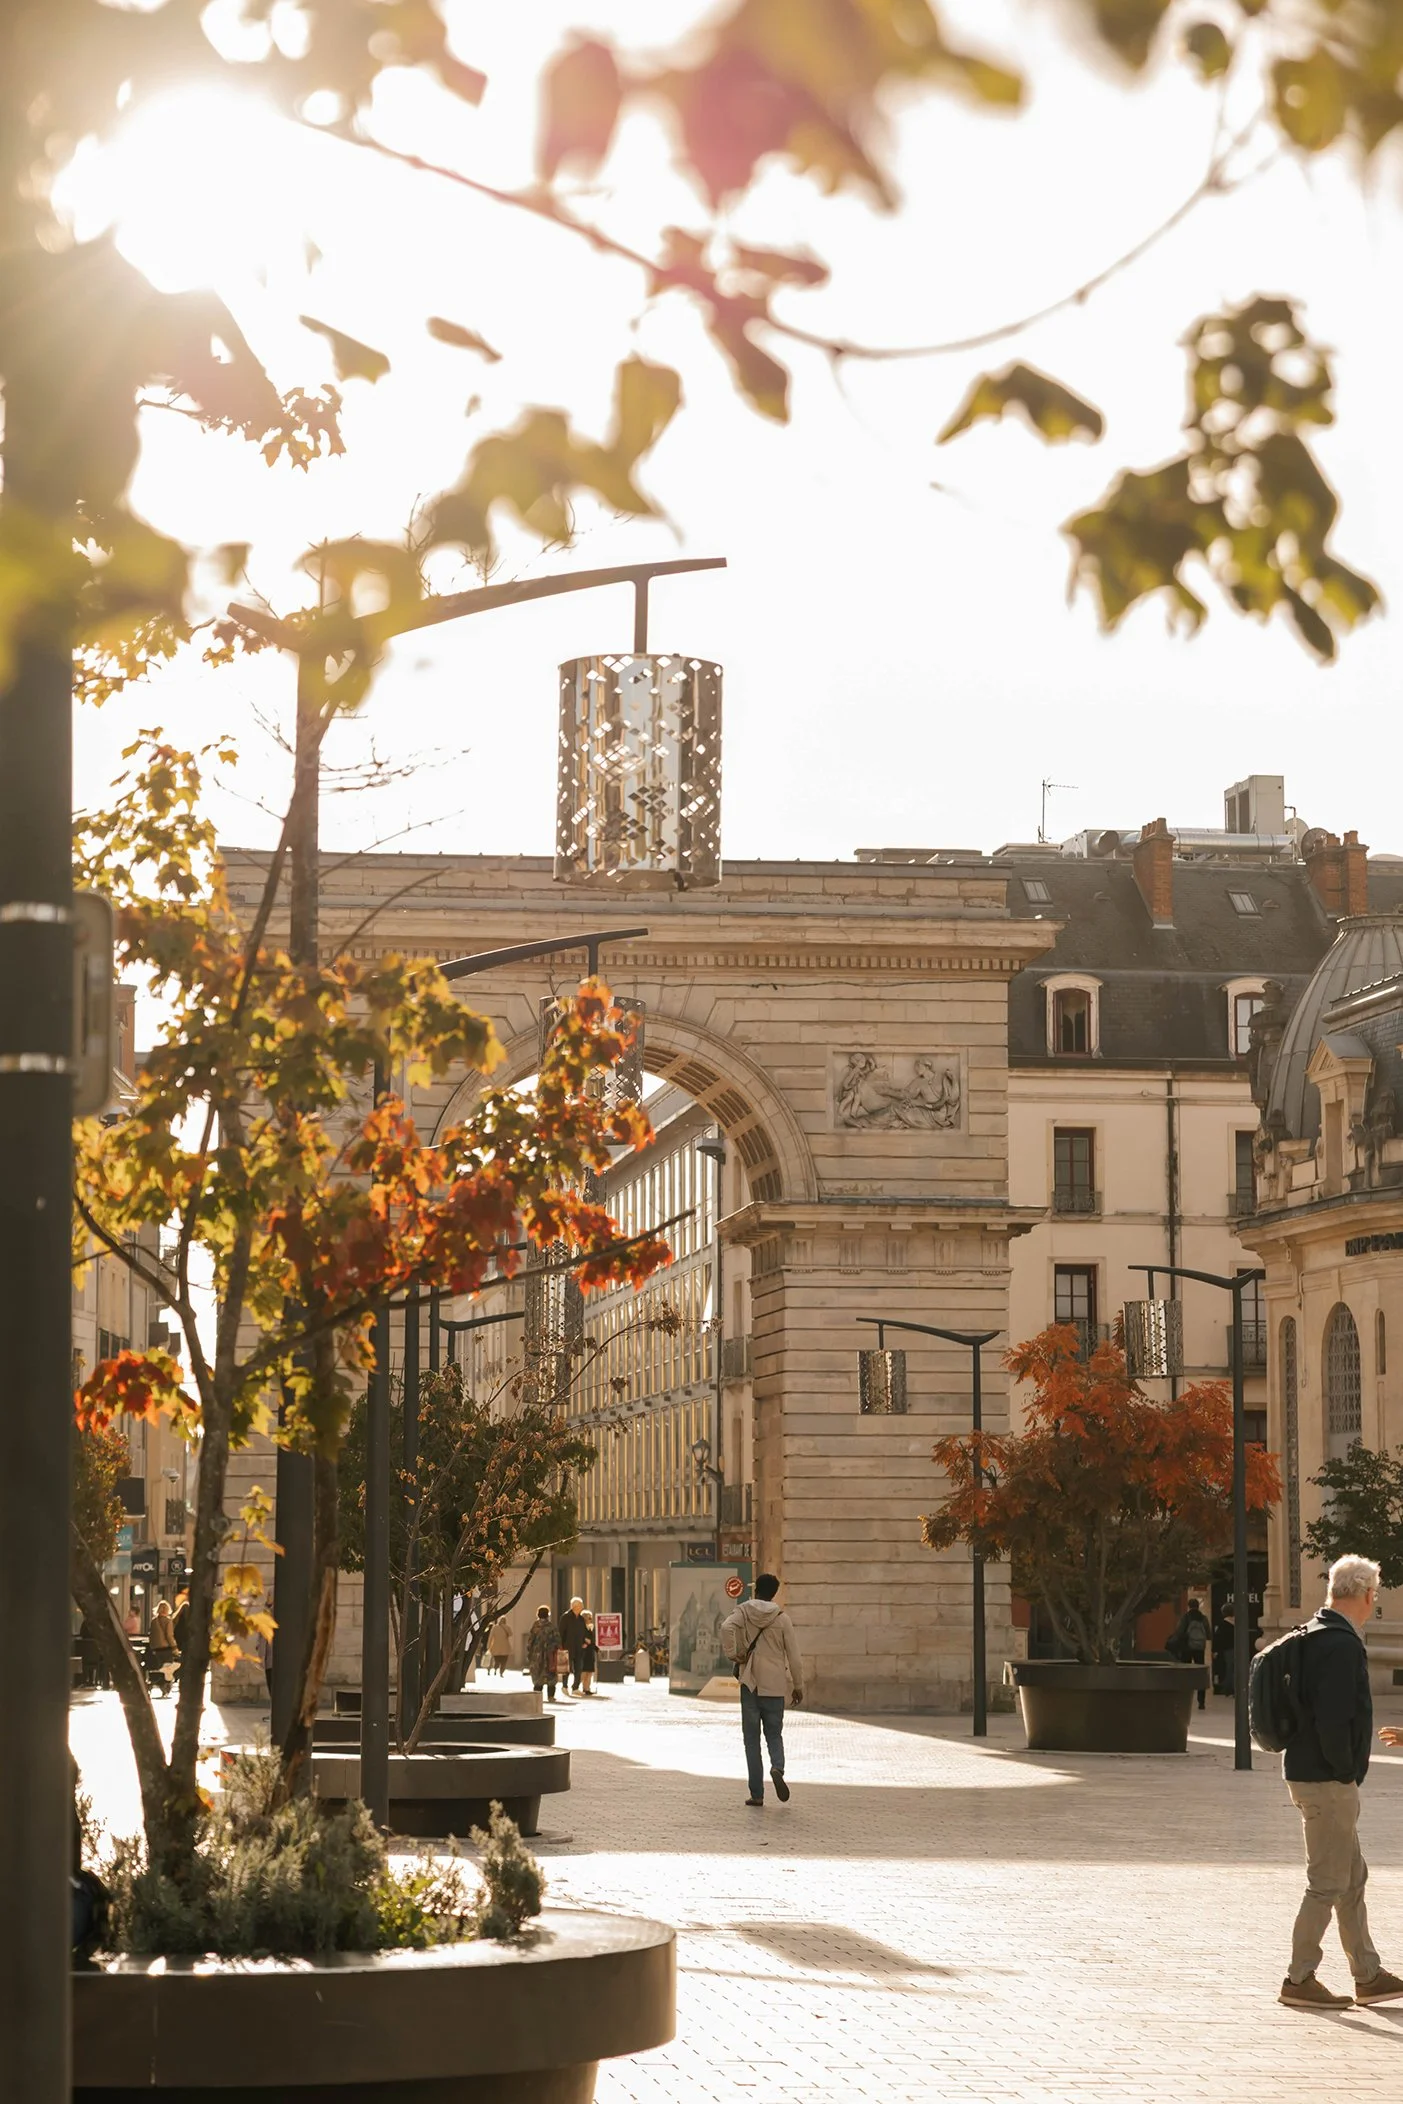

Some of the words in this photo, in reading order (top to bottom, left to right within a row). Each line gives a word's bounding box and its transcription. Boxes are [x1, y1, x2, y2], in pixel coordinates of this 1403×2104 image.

[689, 1547, 711, 1556] LCL
[132, 1562, 155, 1572] ATOL
[1226, 1592, 1260, 1603] HEL
